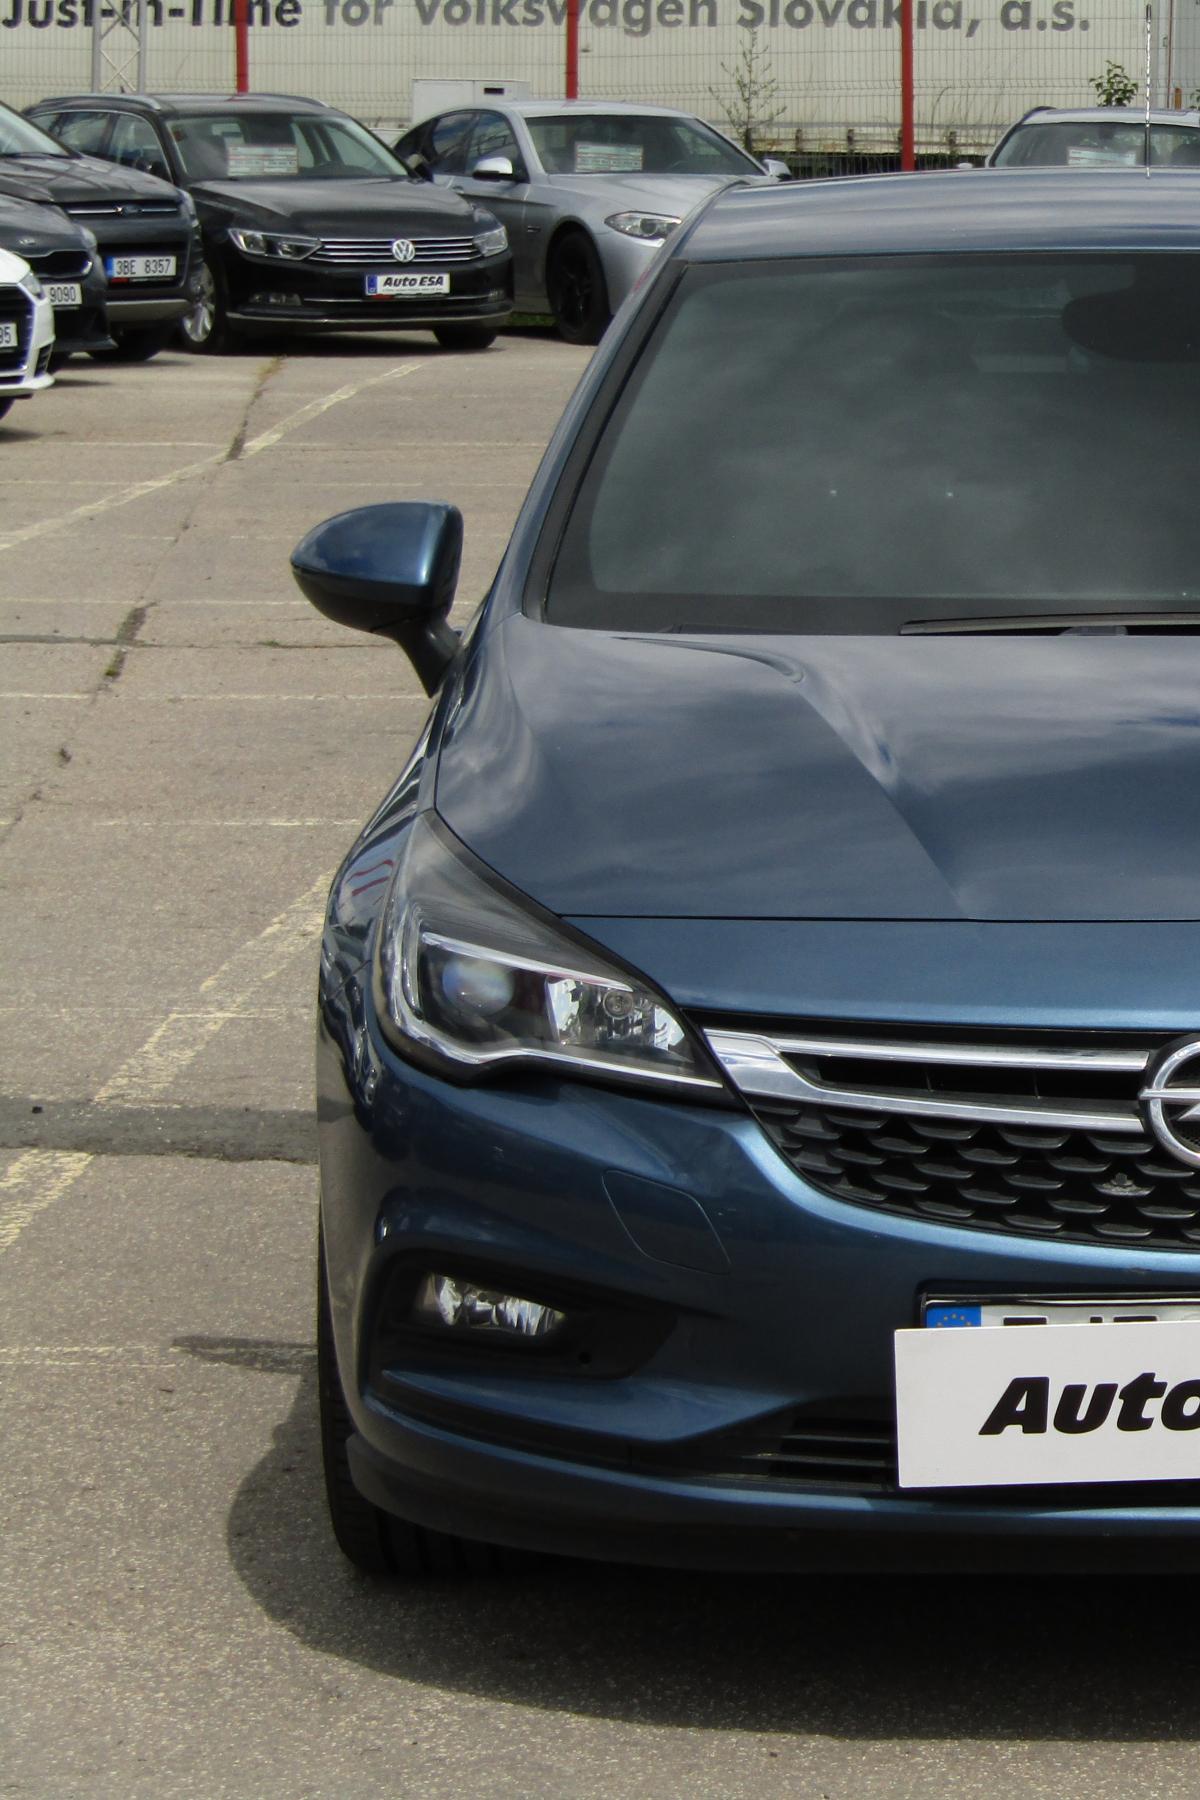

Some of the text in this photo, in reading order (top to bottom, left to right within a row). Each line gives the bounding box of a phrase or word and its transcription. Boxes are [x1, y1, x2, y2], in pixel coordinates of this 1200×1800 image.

[322, 0, 391, 26] for
[414, 0, 719, 37] Volkswagen
[737, 0, 981, 38] Slovakia,
[999, 0, 1090, 31] a.s.
[116, 258, 171, 275] 3BE 8357
[383, 275, 444, 287] Auto ESA
[50, 286, 77, 303] 9090
